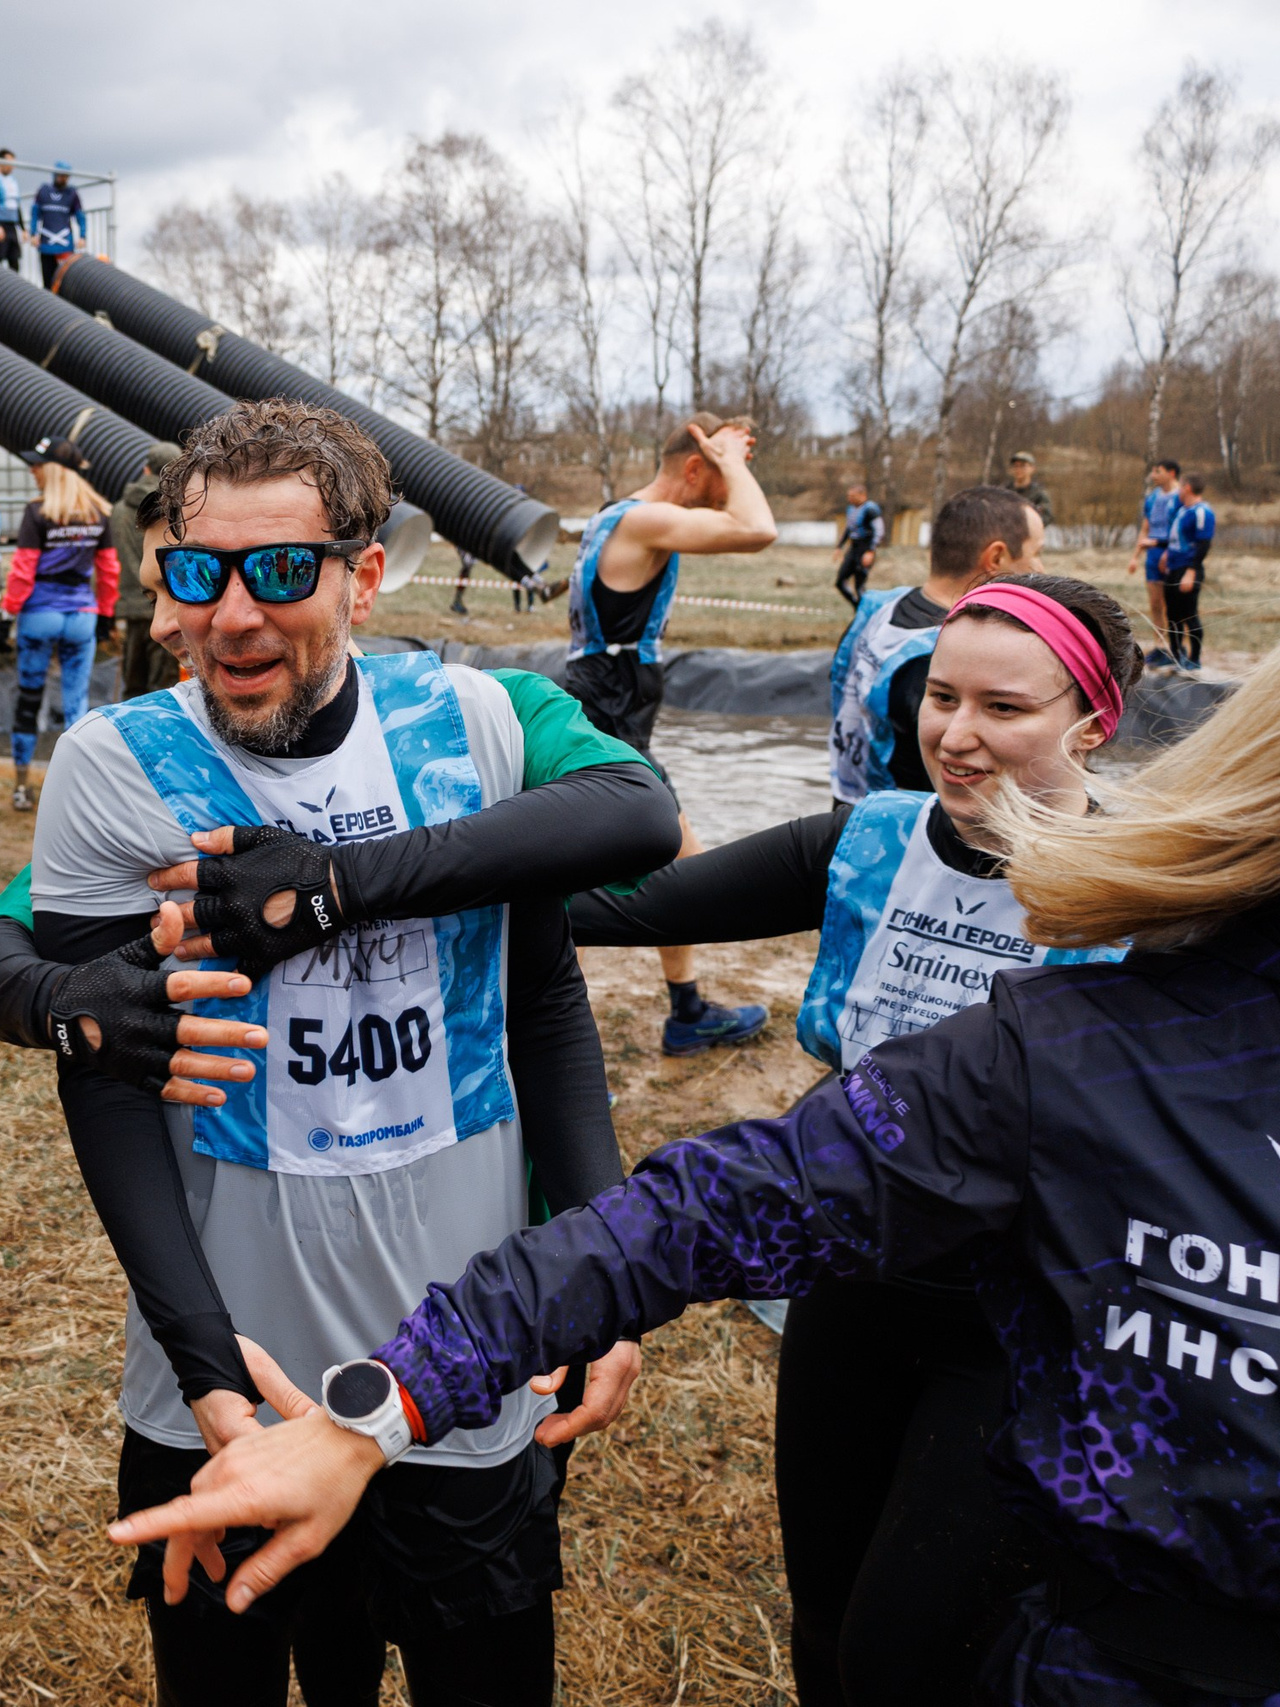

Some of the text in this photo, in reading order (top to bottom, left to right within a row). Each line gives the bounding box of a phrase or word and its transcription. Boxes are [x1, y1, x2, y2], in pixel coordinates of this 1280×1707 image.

[311, 894, 333, 931] TORQ
[951, 923, 1036, 956] ГЕРОЕВ
[887, 941, 995, 992] Sminex
[873, 995, 897, 1010] FINE
[288, 1005, 432, 1088] 5400
[867, 1063, 911, 1117] LEAGUE
[338, 1115, 426, 1148] ГАЗПРОМБАНК
[1124, 1217, 1280, 1304] ГОН
[1103, 1304, 1279, 1397] ИНС
